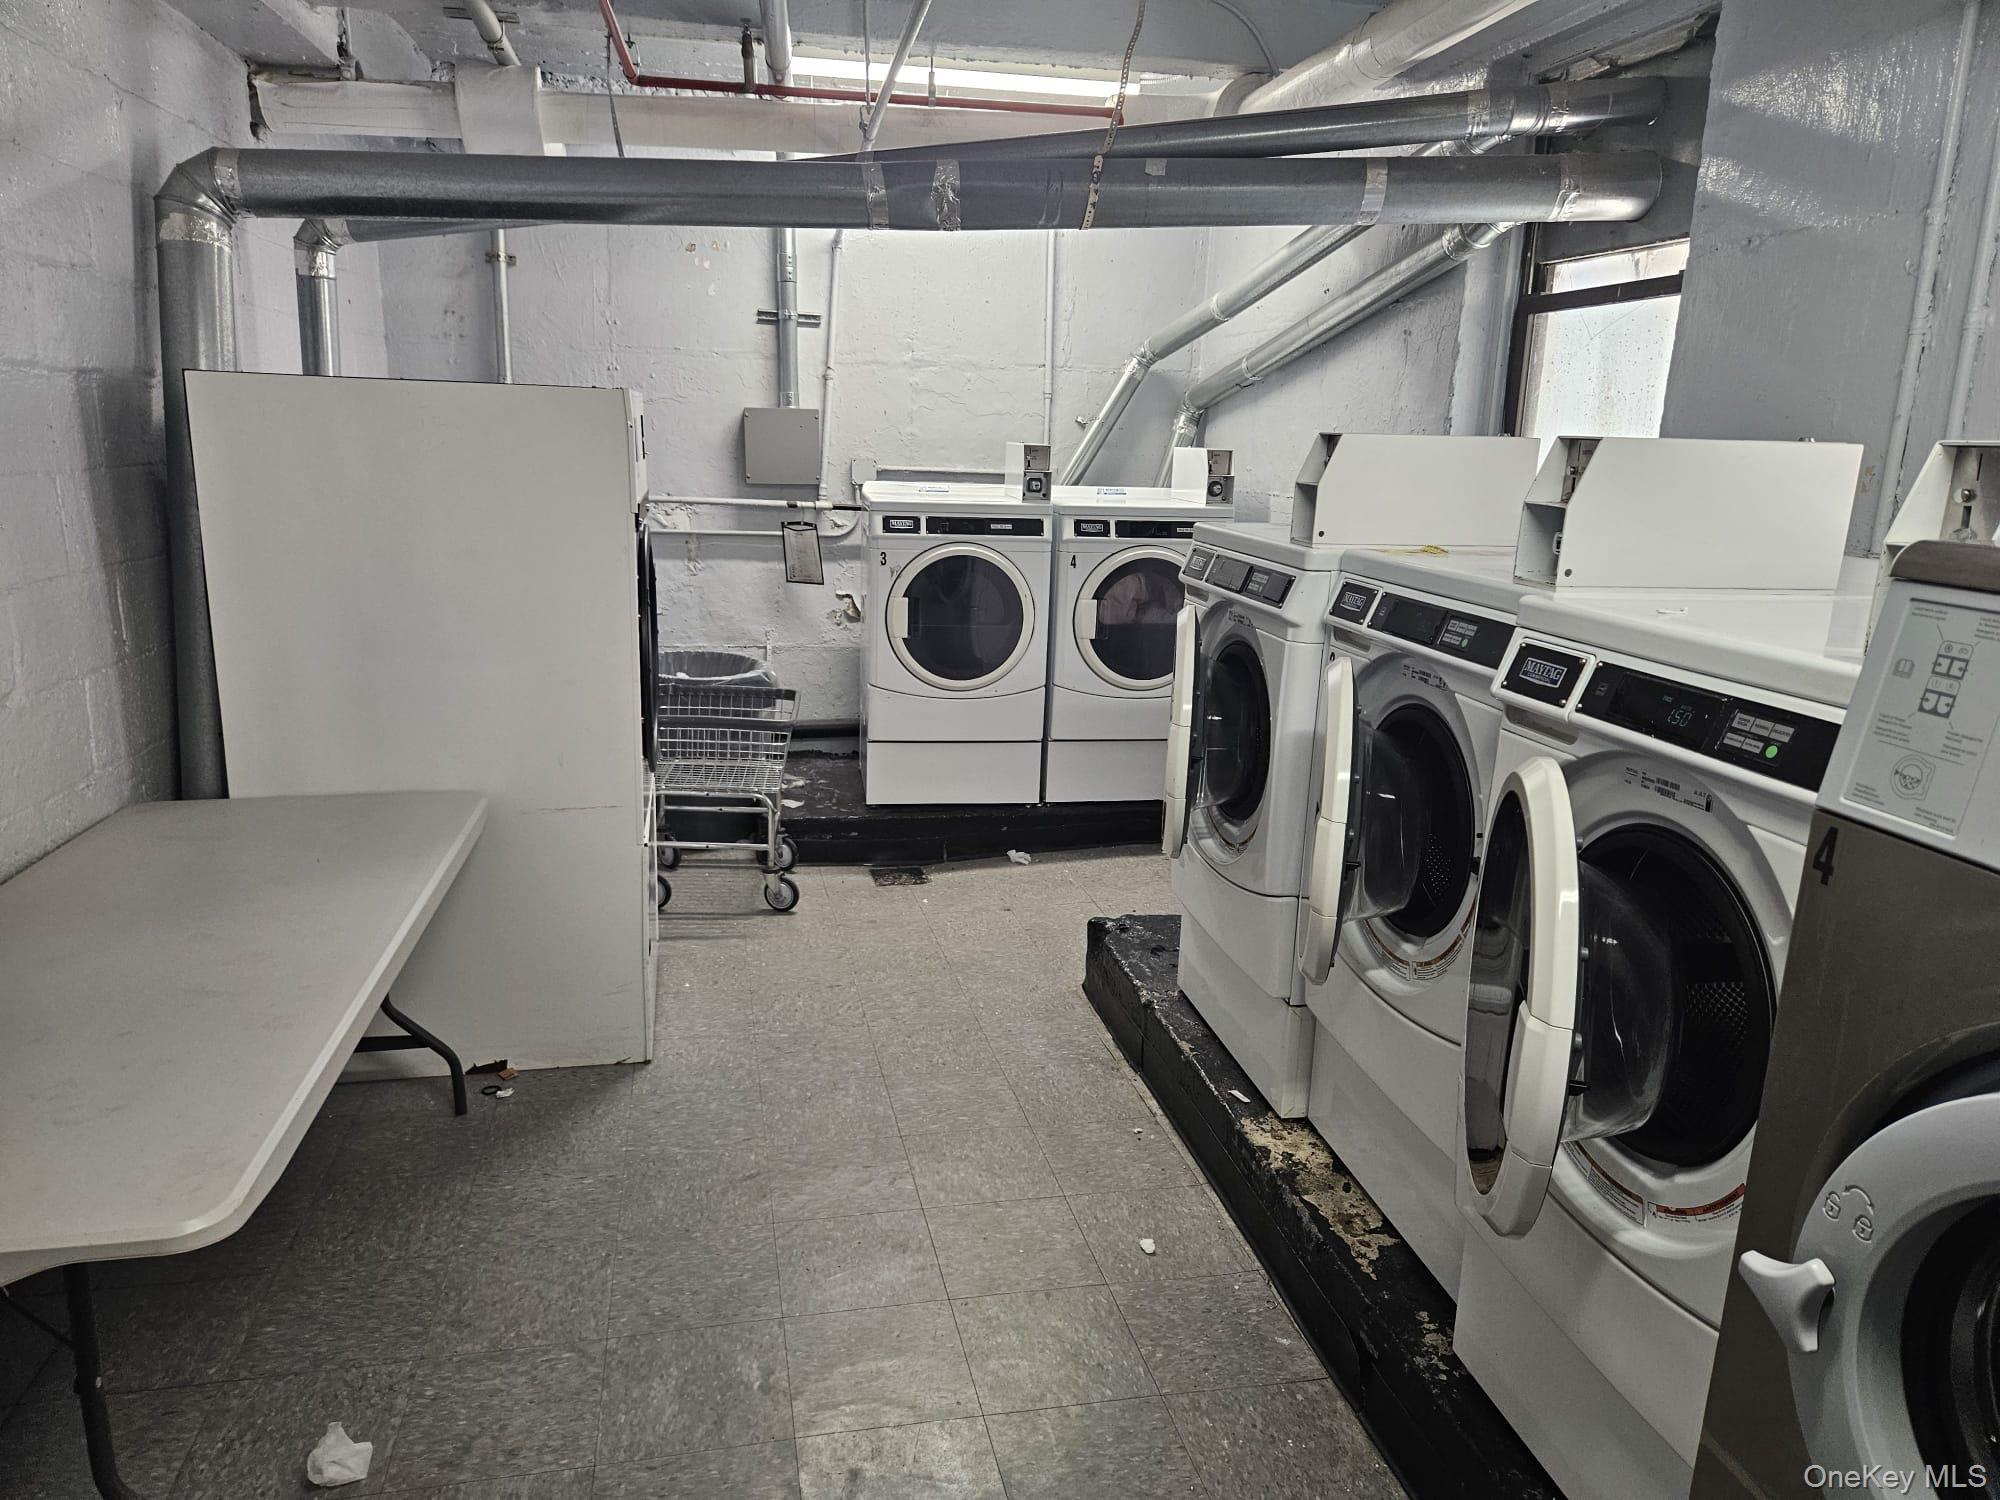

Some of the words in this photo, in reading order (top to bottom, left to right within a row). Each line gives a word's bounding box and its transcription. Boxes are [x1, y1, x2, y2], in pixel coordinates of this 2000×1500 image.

[880, 551, 888, 566] 3
[1070, 554, 1077, 569] 4
[1524, 660, 1562, 680] MAYTAG
[1812, 826, 1839, 886] 4
